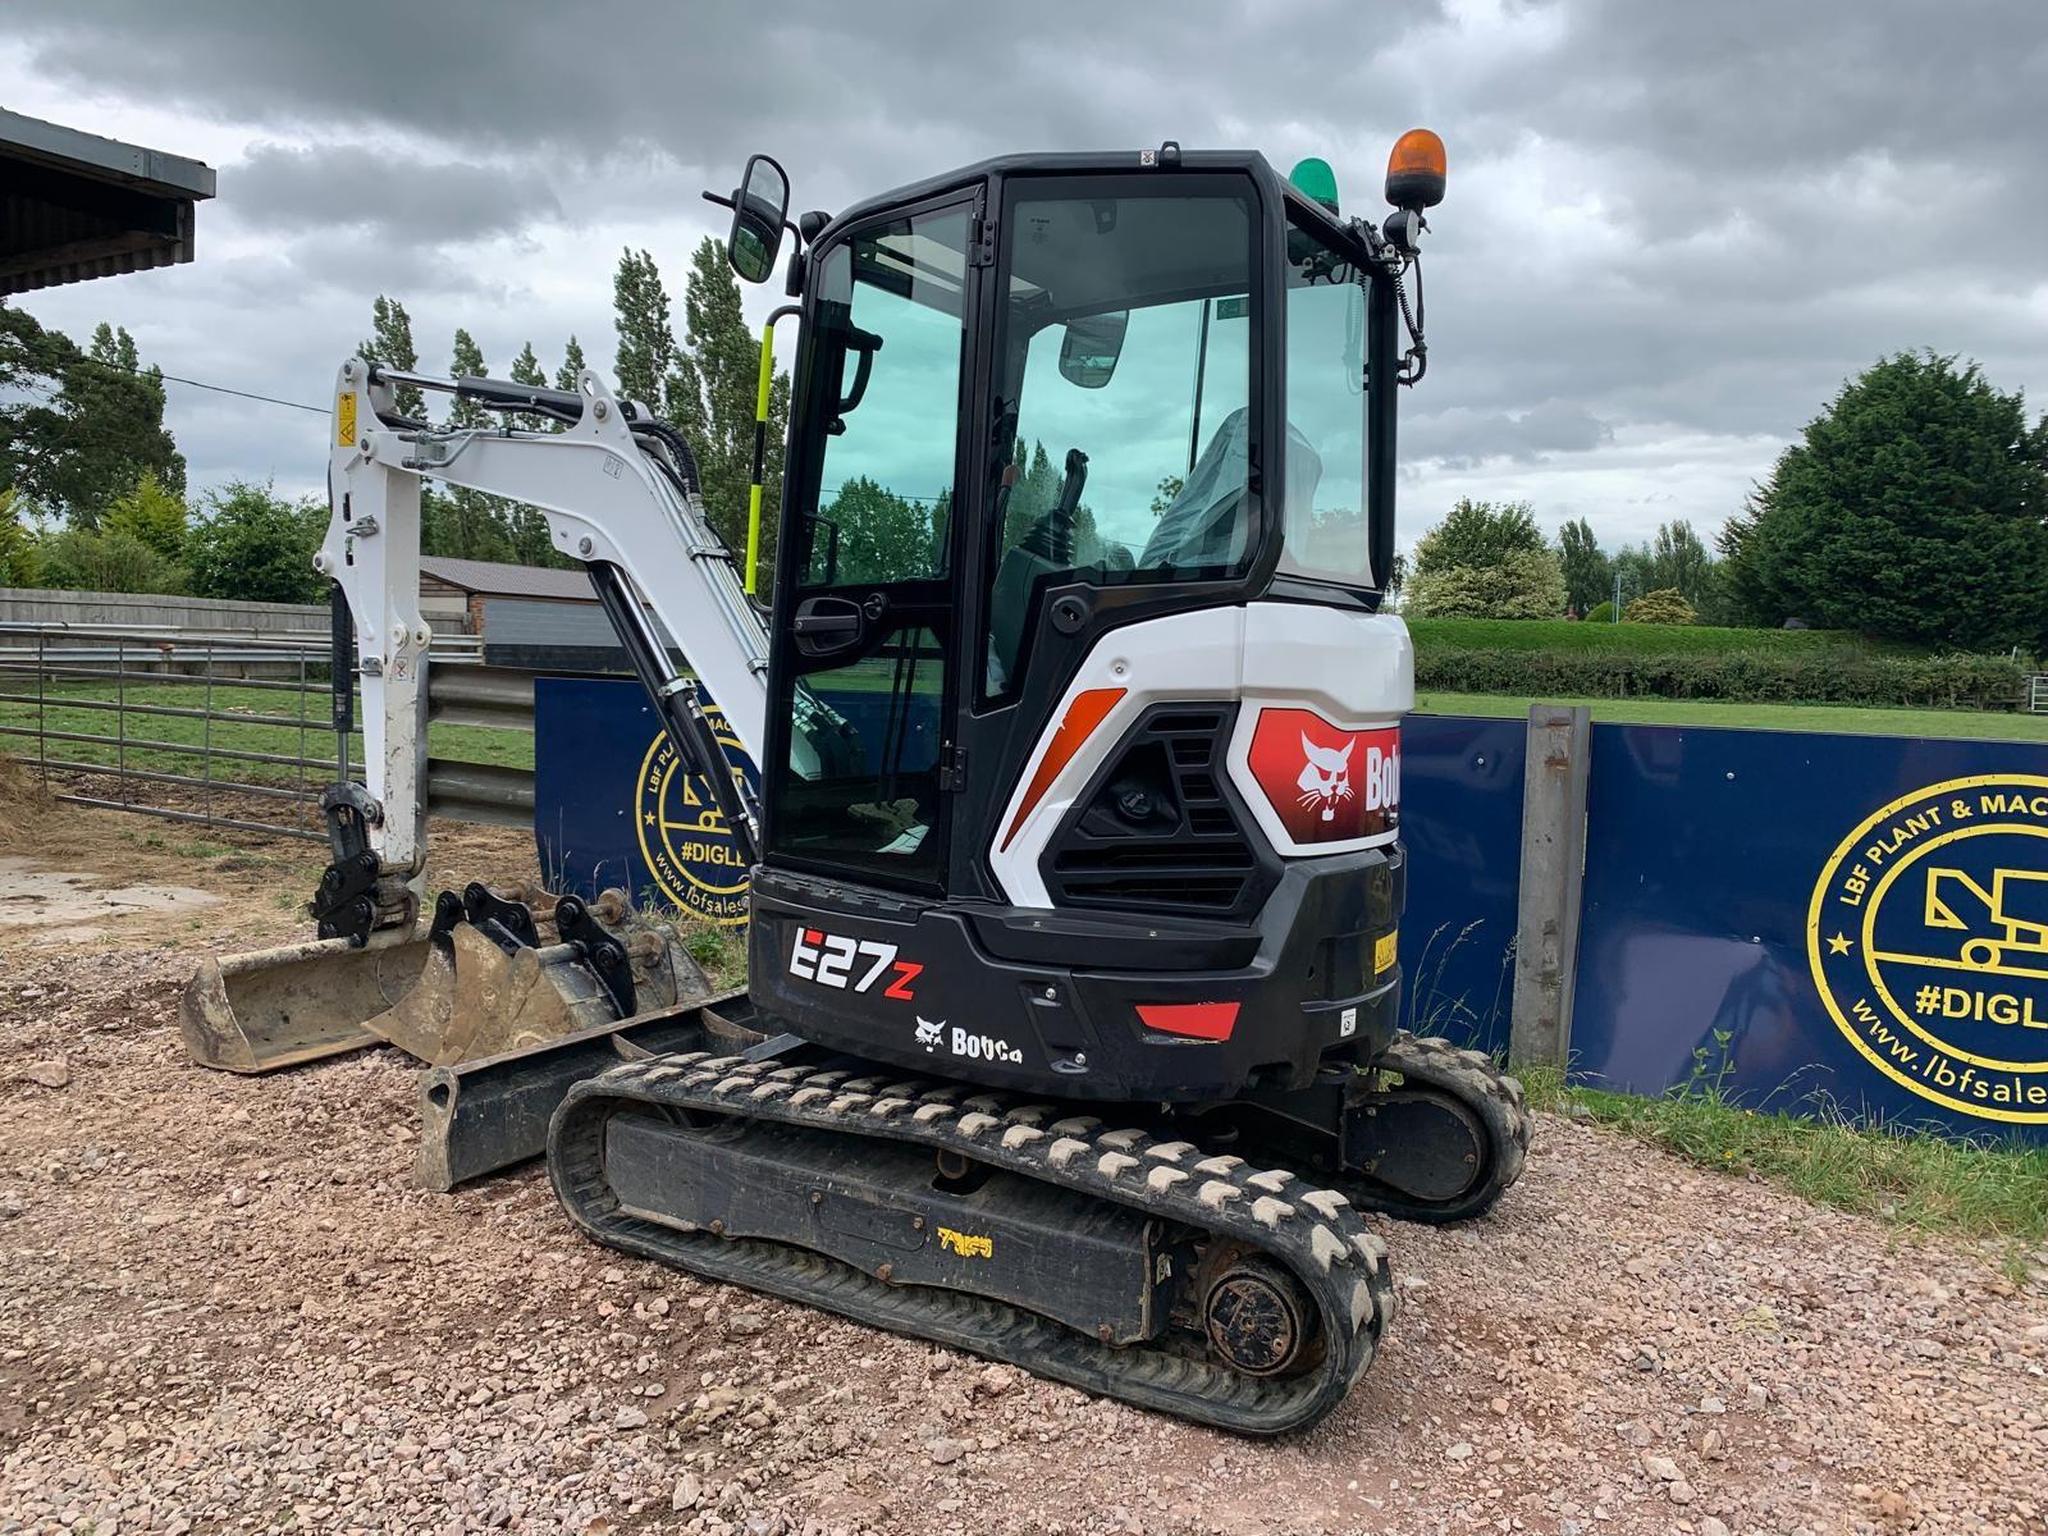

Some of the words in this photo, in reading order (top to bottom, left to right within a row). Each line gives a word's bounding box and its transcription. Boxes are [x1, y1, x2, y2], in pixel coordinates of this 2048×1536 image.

[648, 765, 662, 794] LBF
[1840, 864, 1872, 906] LBF
[1866, 807, 1942, 865] PLANT
[1952, 800, 1973, 819] &
